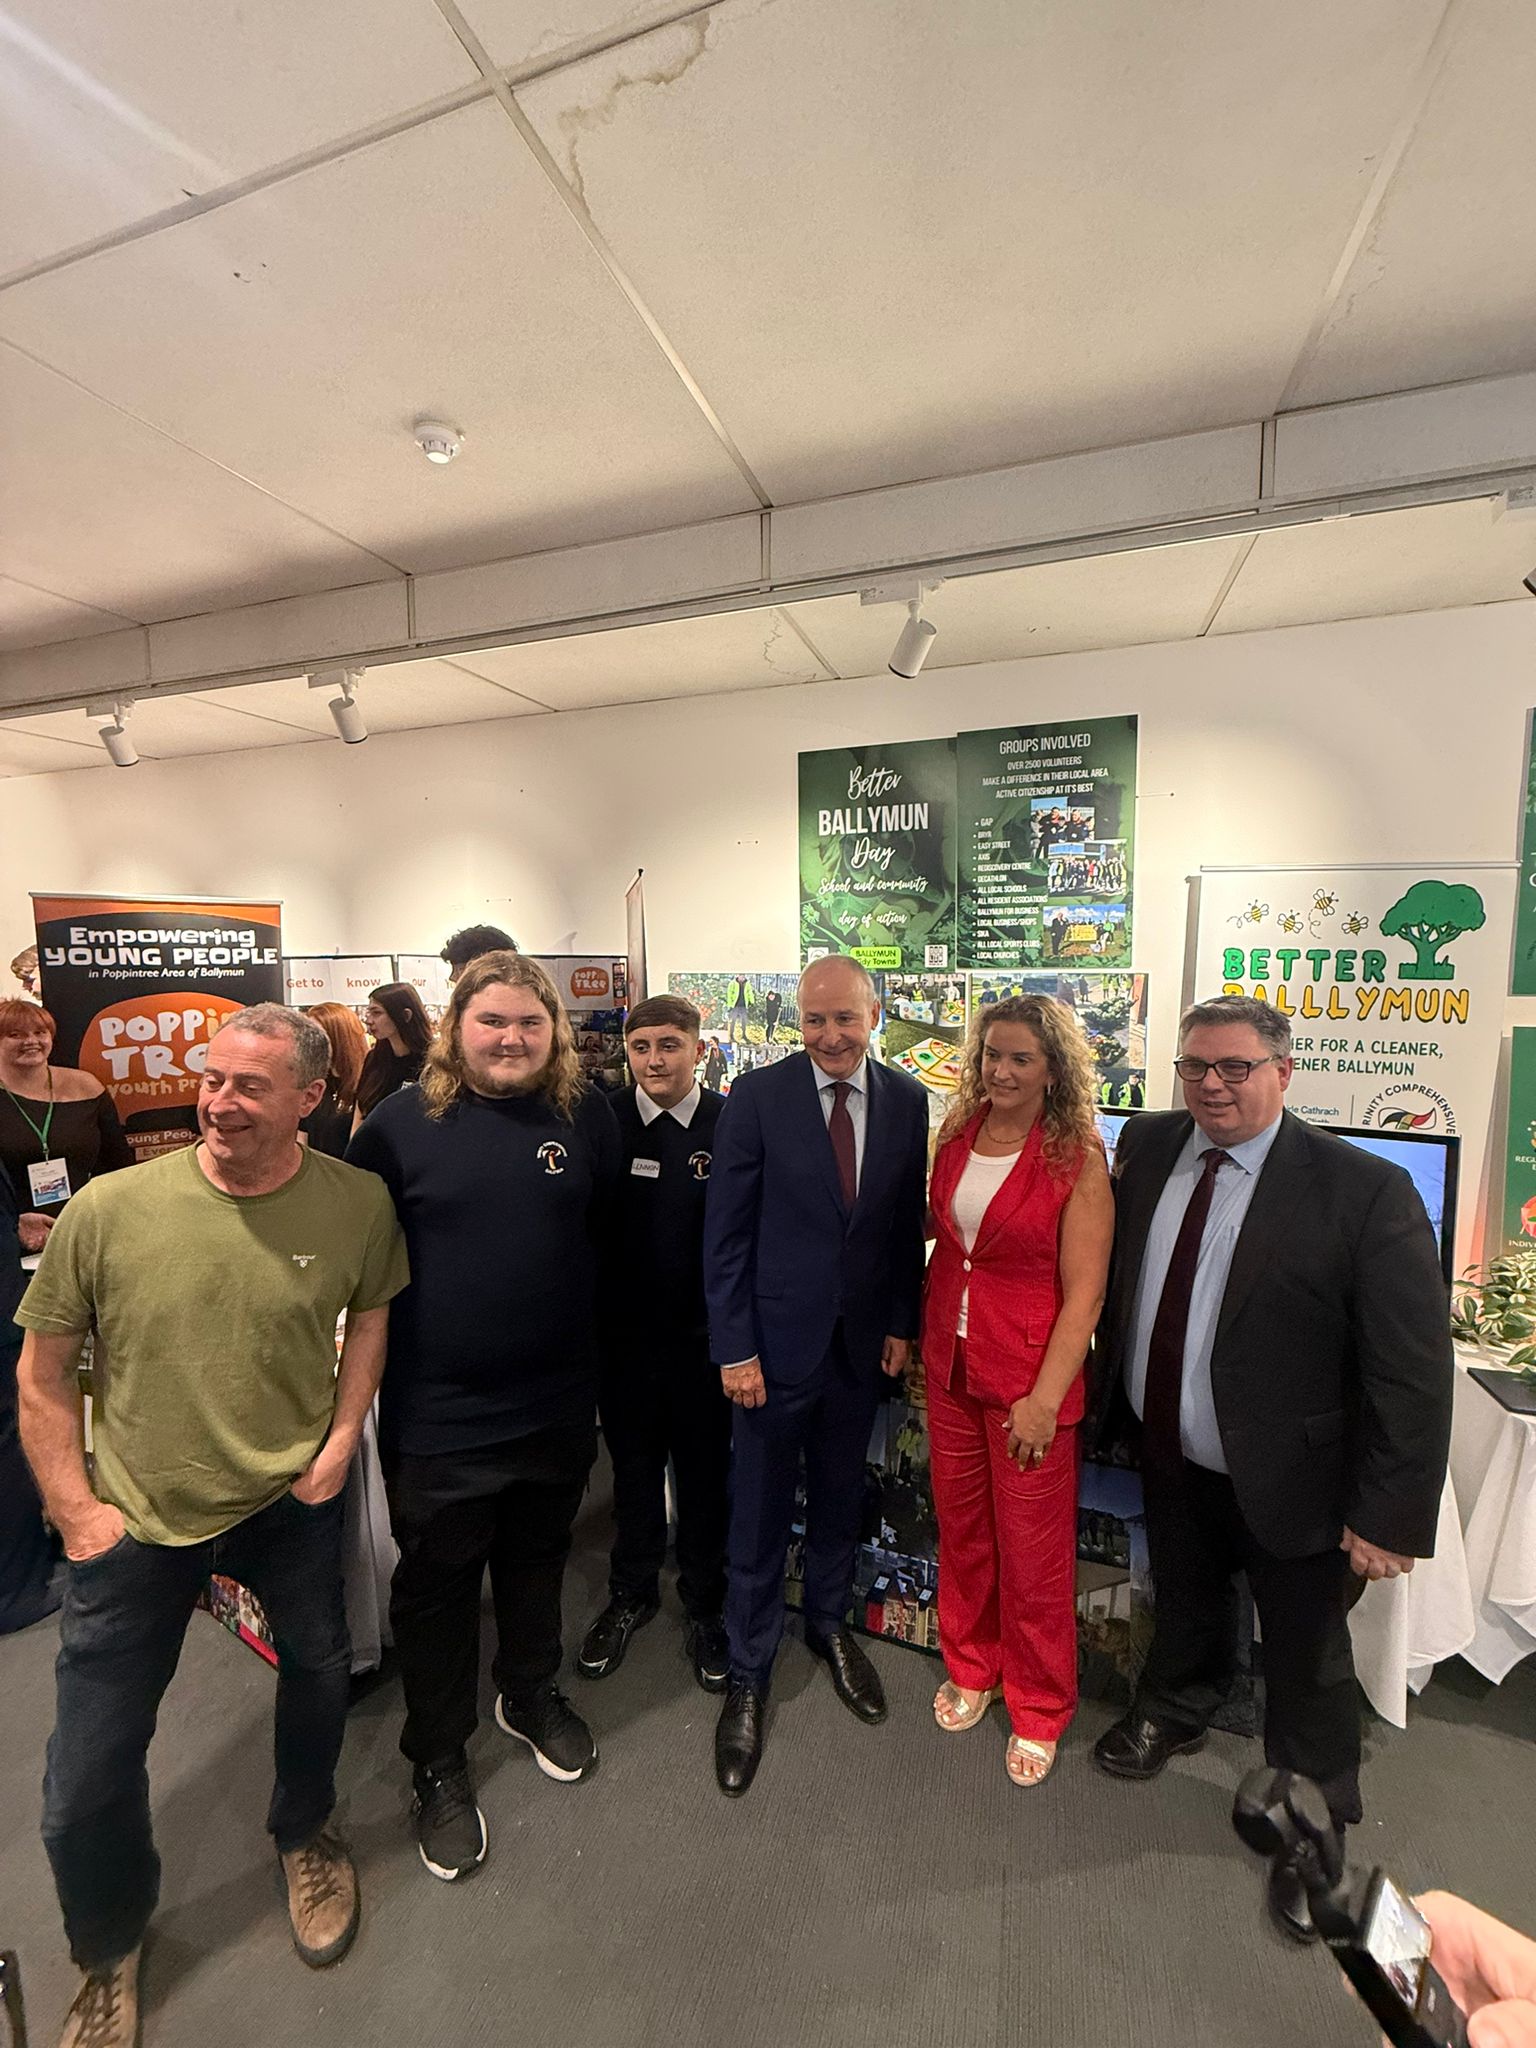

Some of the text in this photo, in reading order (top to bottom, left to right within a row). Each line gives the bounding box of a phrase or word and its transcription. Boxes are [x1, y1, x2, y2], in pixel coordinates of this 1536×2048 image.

[999, 733, 1091, 755] GROUPS INVOLVED
[1007, 756, 1082, 771] OVER 2500 VOLUNTEERS
[848, 765, 902, 800] Better
[982, 767, 1109, 786] MAKE A DIFFERENCE IN THEIR LOCAL AREA
[995, 782, 1094, 799] ACTIVE CITIZENSHIP AT IT'S BEST
[818, 803, 929, 836] BALLYMUN
[977, 840, 1011, 849] EASY STREET
[851, 836, 896, 871] Day
[977, 861, 1032, 872] REDISCOVERY CENTRE
[818, 875, 929, 895] School and community
[977, 884, 1028, 894] ALL LOCAL SCHOOLS
[977, 897, 987, 905] ALL
[1011, 895, 1048, 903] ASSOCIATIONS
[977, 906, 1039, 916] BALLYMUN FOR BUSINESS
[838, 910, 908, 929] day of action
[977, 919, 993, 927] LOCAL
[69, 926, 256, 947] Empowering
[987, 940, 1003, 948] LOCAL
[1003, 940, 1023, 948] SPORTS
[44, 947, 278, 966] YOUNG PEOPLE
[976, 951, 993, 959] LOCAL
[1222, 947, 1387, 983] BETTER
[88, 967, 245, 980] in Poppintree Area of Ballymun
[286, 976, 381, 989] Get to know
[412, 978, 426, 987] our
[1320, 1038, 1351, 1051] FOR
[1354, 1039, 1365, 1053] A
[1371, 1040, 1444, 1059] CLEANER,
[1293, 1057, 1414, 1076] ENER BALLYMUN
[1300, 1105, 1340, 1116] Cathrach
[1362, 1083, 1456, 1135] RINITY COMPREHENSIVE
[126, 1133, 160, 1145] oung
